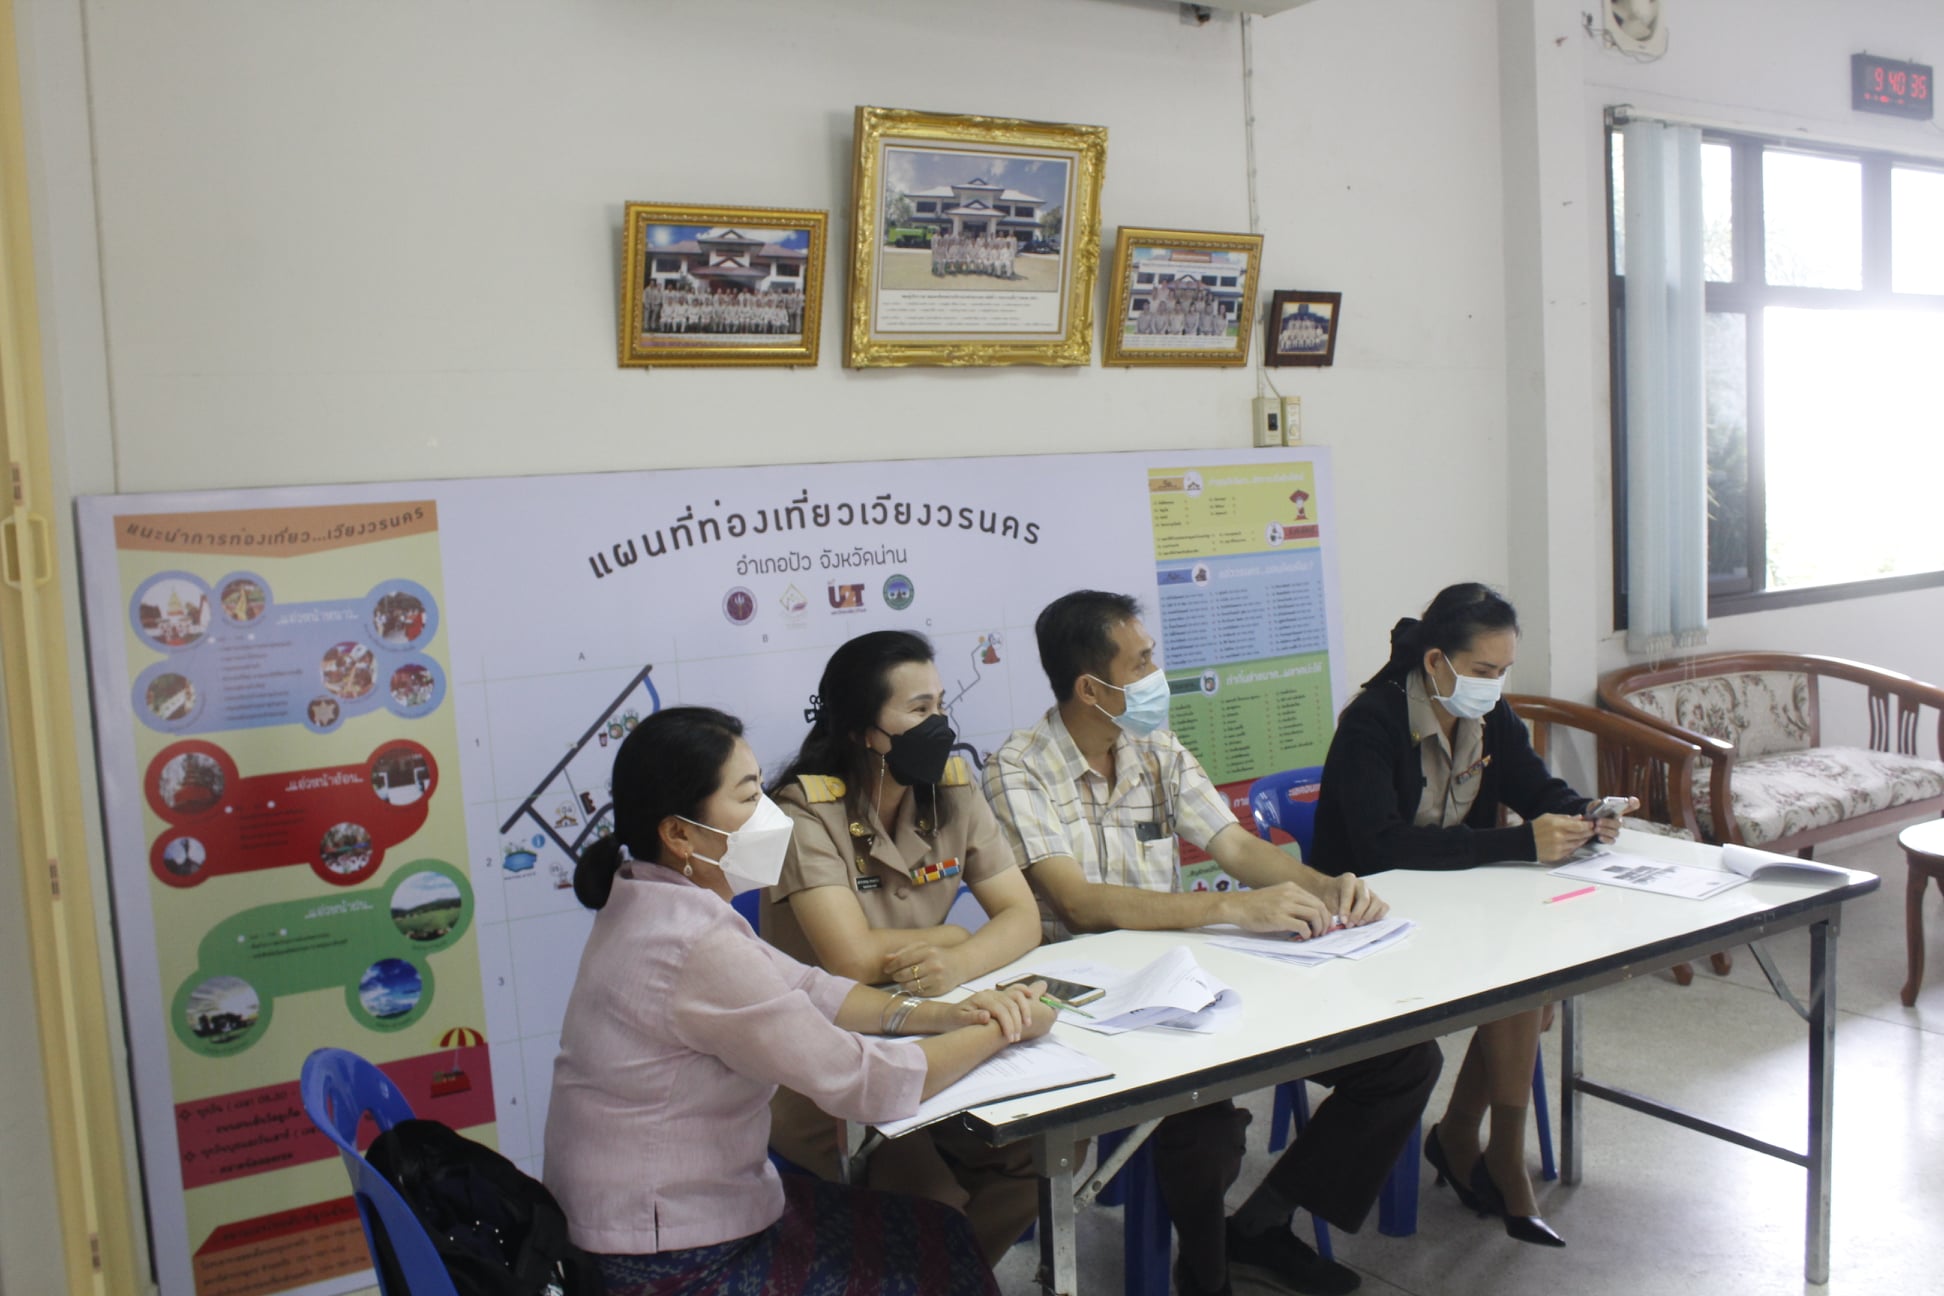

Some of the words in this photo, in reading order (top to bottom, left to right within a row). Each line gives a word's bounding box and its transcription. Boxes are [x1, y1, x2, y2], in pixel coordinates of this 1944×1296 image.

[1874, 67, 1884, 92] 9
[1888, 71, 1907, 96] 40
[588, 489, 1040, 579] แผนที่ท่องเที่ยวเวียงวรนคร
[737, 552, 812, 575] อำเภอปัว
[820, 544, 907, 569] จังหวัดน่าน
